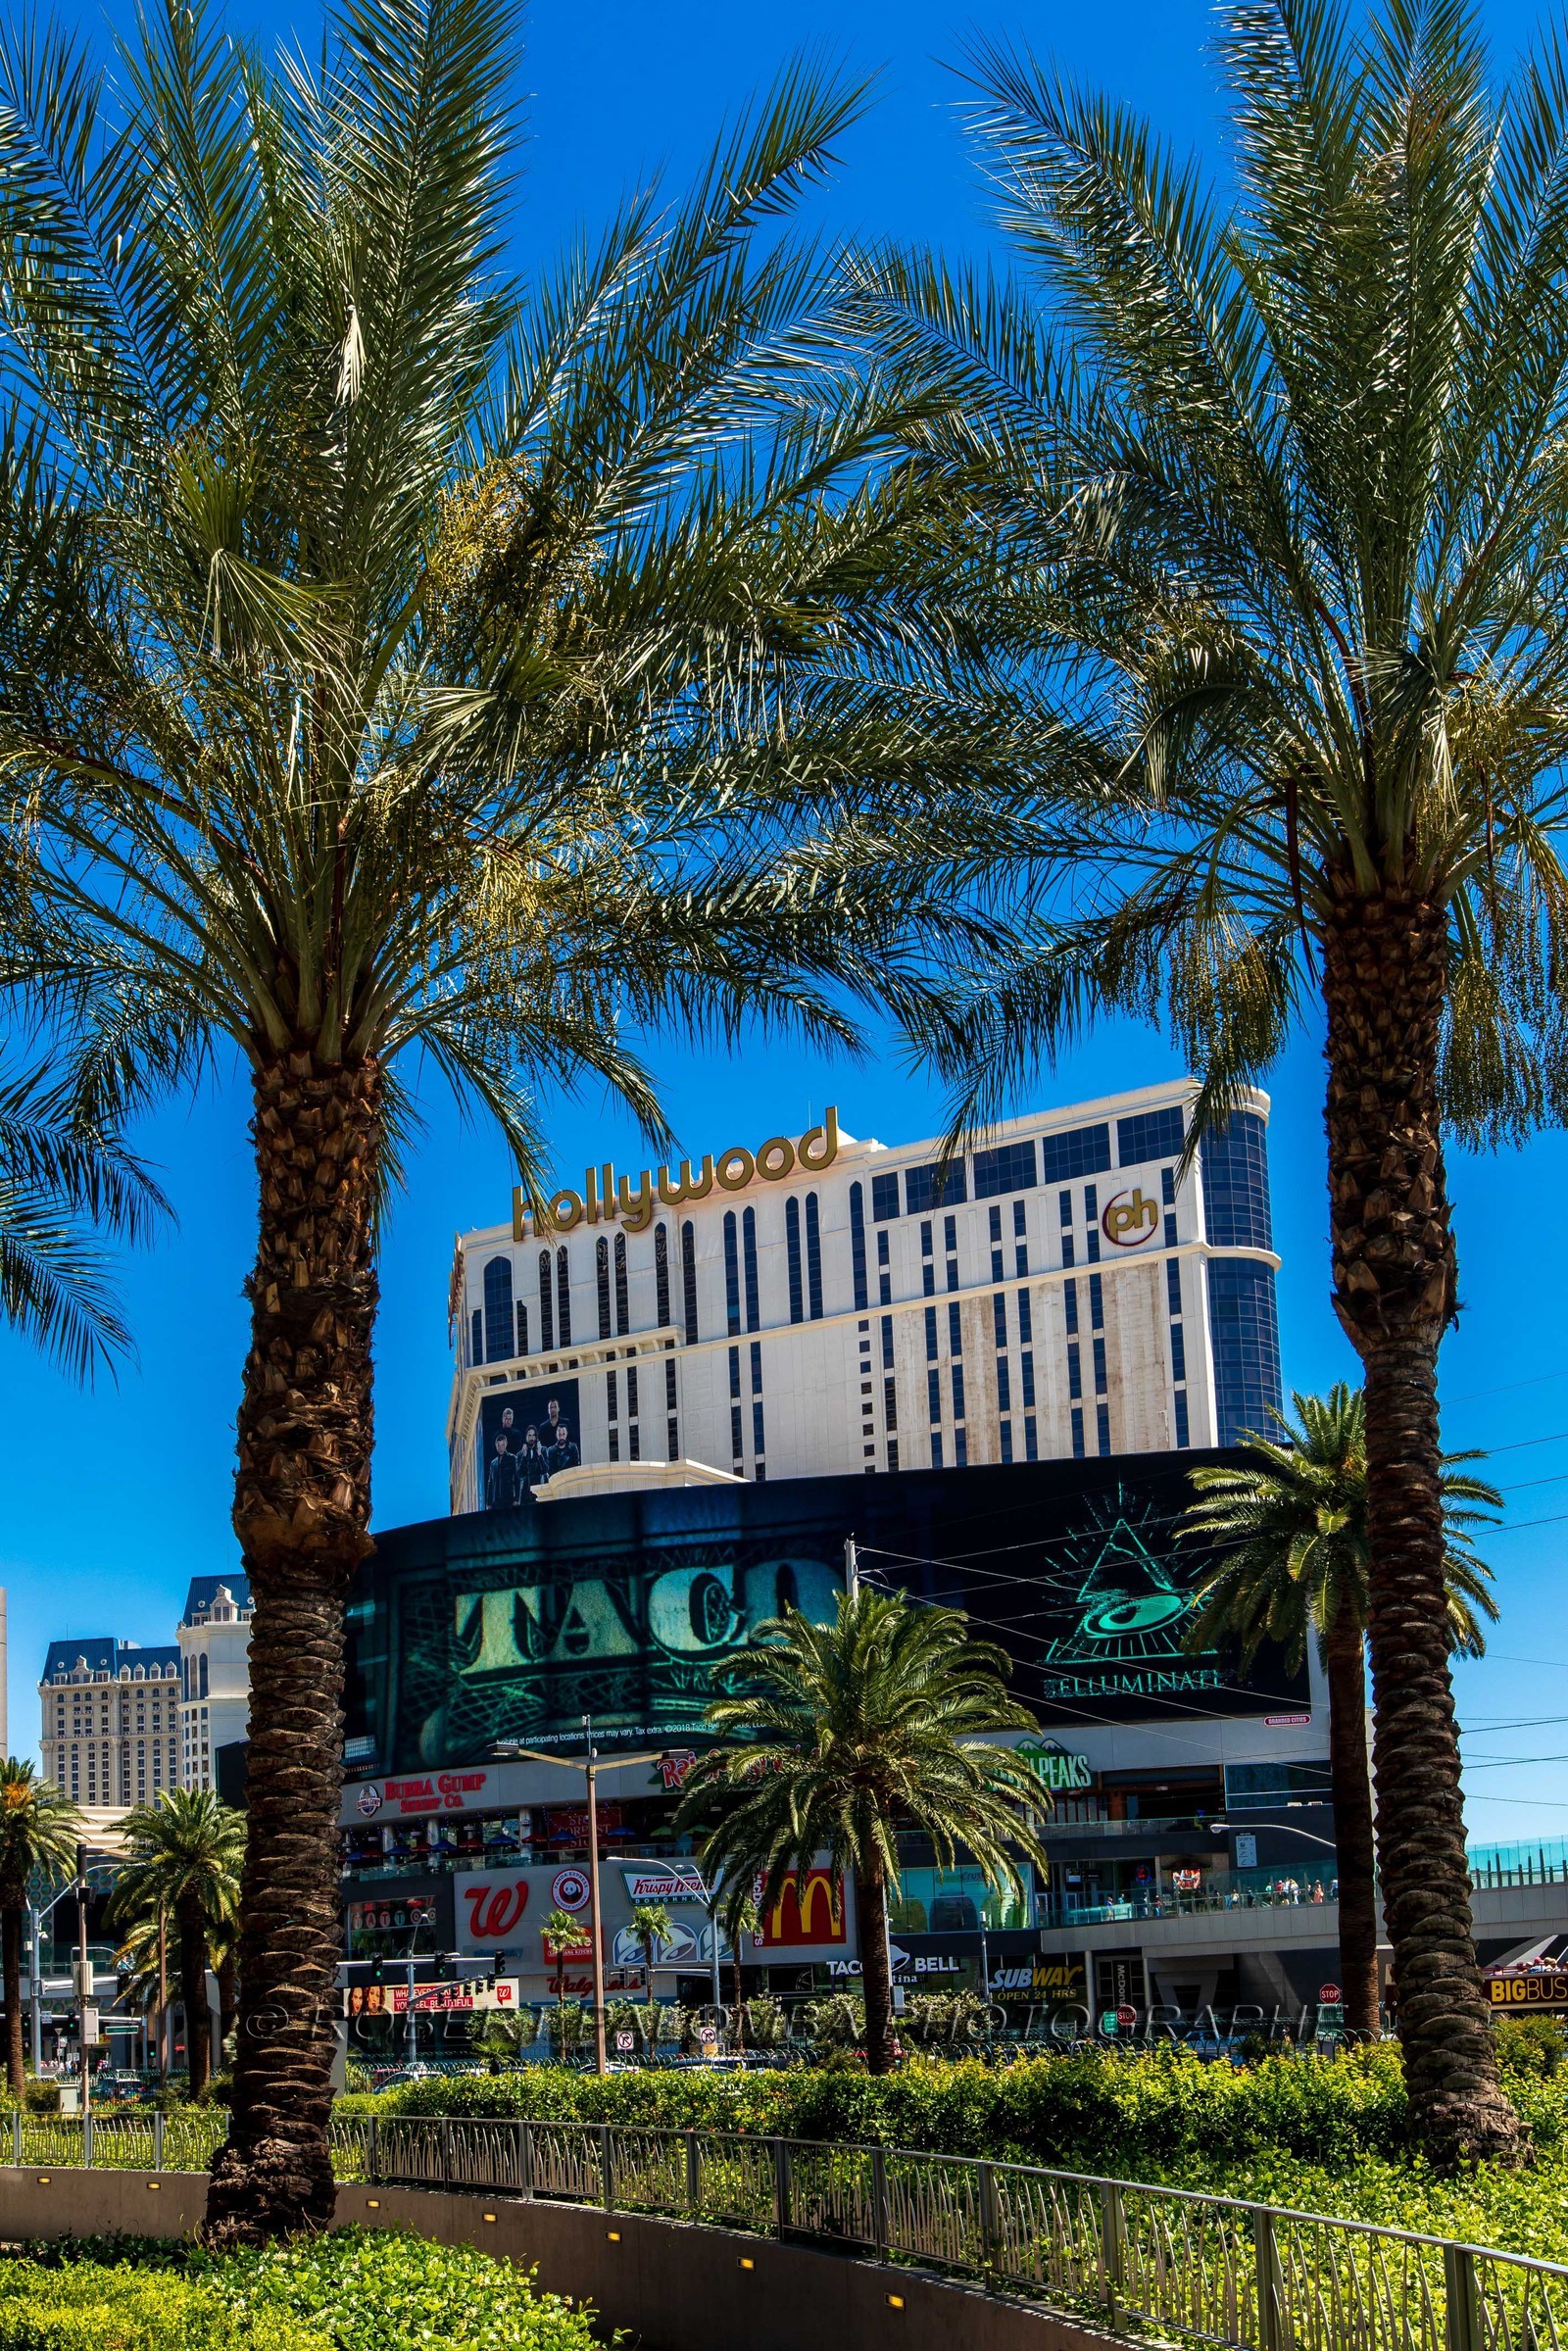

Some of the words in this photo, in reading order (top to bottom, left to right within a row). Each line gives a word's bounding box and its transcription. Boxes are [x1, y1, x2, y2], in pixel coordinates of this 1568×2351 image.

[513, 1105, 839, 1242] hollywood
[1106, 1188, 1158, 1243] ph
[525, 1734, 559, 1745] participating
[587, 1730, 605, 1739] Prices
[606, 1730, 619, 1739] may
[619, 1728, 634, 1738] vary.
[635, 1726, 646, 1735] Tax
[647, 1726, 663, 1735] extra.
[691, 1723, 707, 1732] Taco
[1039, 1754, 1092, 1789] PEAKS
[384, 1778, 434, 1801] BUBBA
[438, 1773, 487, 1794] GUMP
[633, 1878, 674, 1896] Krispy
[826, 1960, 862, 1975] TAC
[915, 1957, 959, 1972] BELL
[988, 1965, 1084, 1989] SUBWAY
[998, 1991, 1029, 2001] OPEN
[1035, 1990, 1047, 1999] 24
[1053, 1988, 1077, 1998] HRS
[1321, 1989, 1339, 1999] STOP
